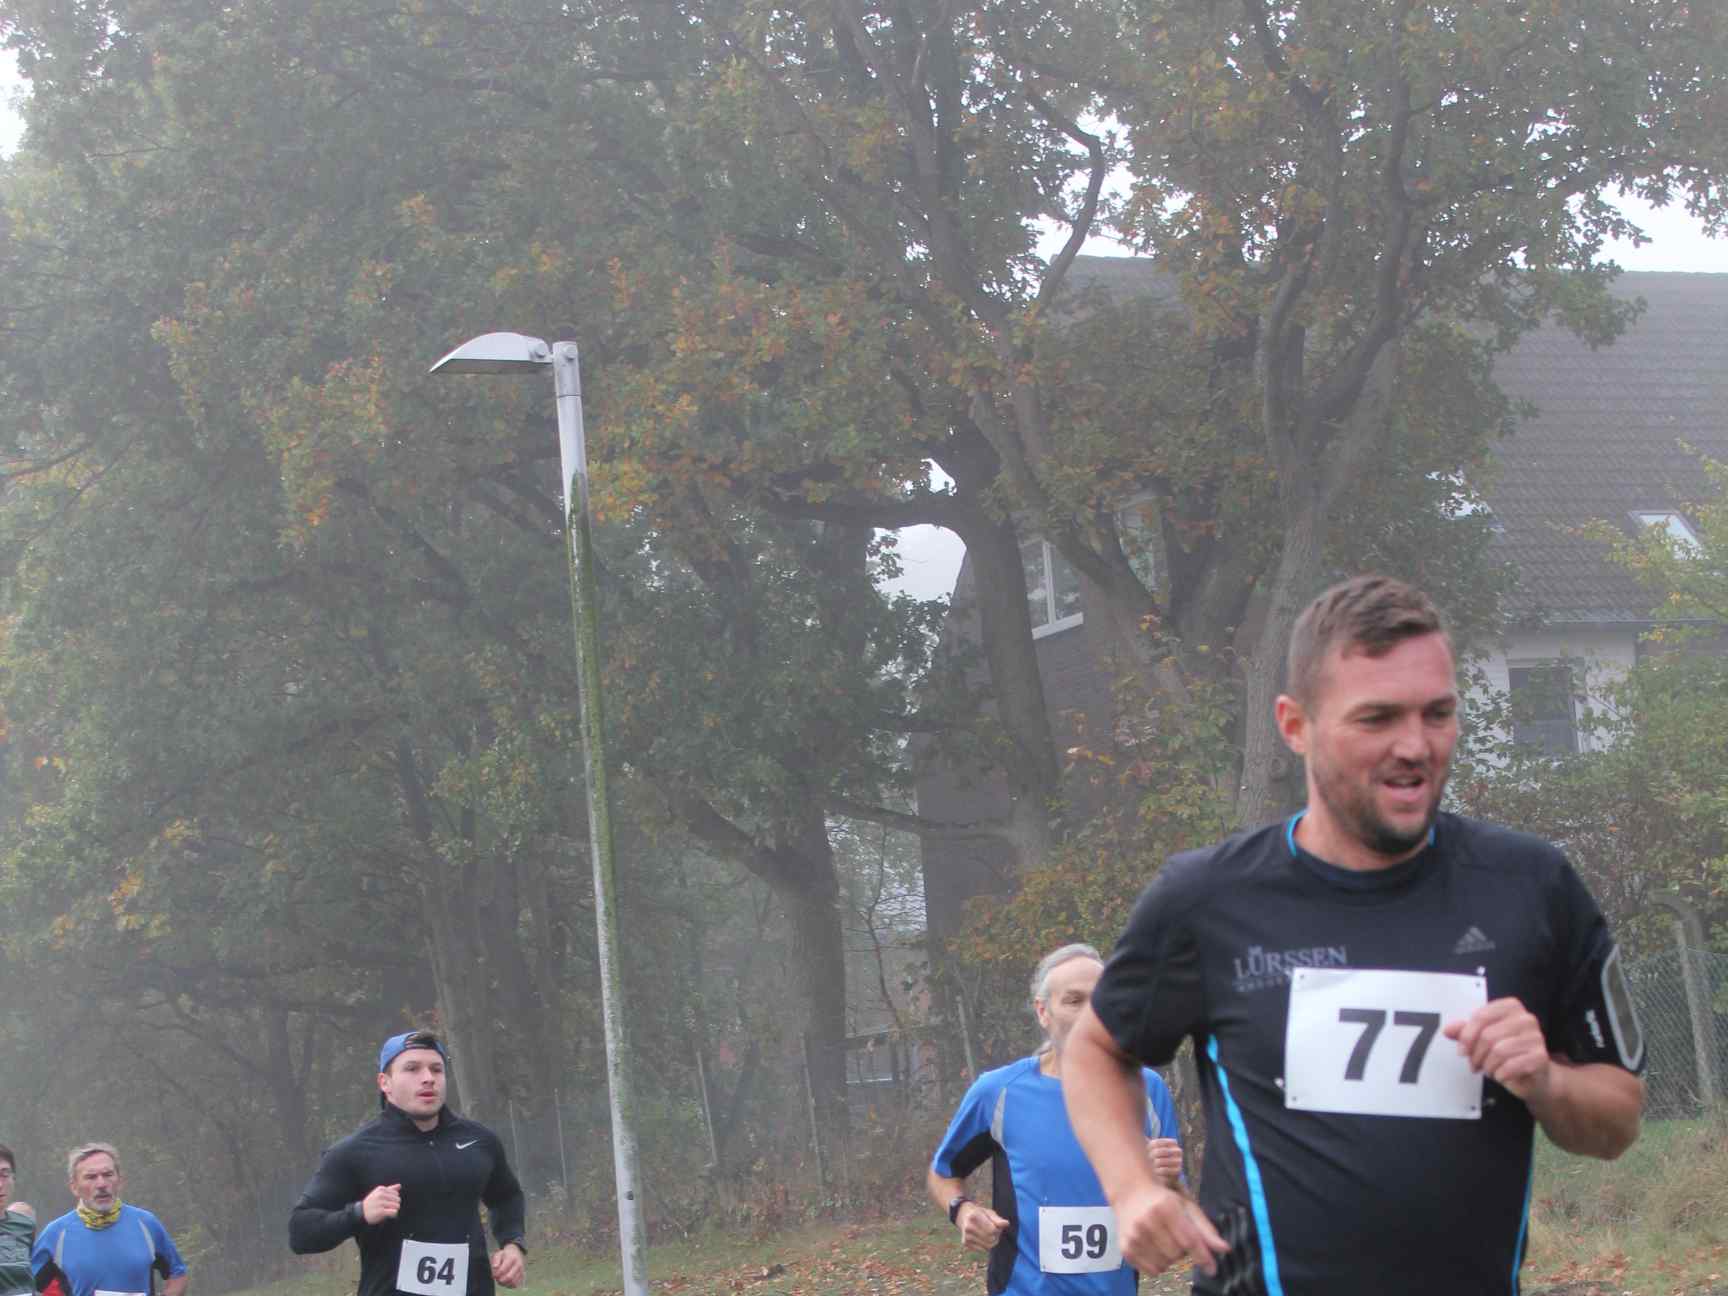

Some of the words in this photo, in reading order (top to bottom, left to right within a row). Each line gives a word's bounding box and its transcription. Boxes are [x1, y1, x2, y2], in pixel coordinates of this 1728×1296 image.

[1338, 1007, 1441, 1085] 77
[1060, 1223, 1108, 1260] 59
[416, 1256, 455, 1286] 64
